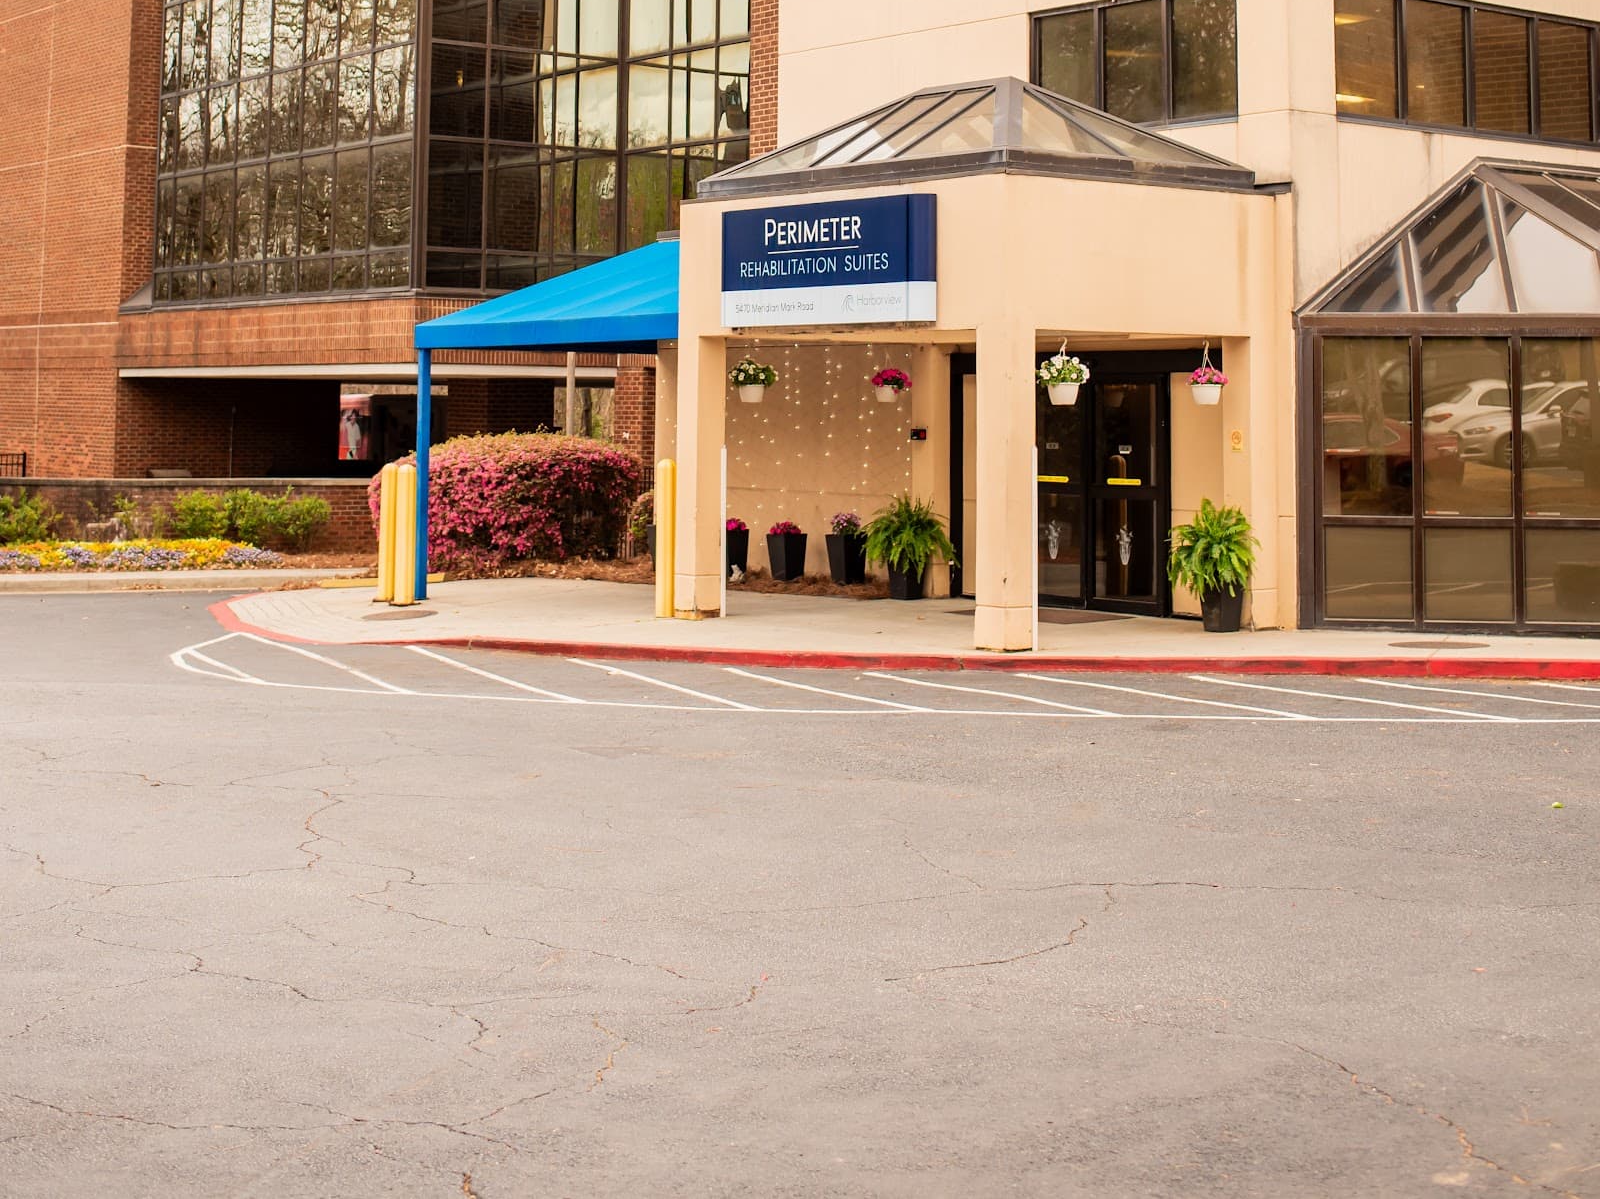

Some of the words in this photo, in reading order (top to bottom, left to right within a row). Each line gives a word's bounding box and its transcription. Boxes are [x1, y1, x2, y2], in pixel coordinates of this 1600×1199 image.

[764, 215, 862, 246] PERIMETER
[740, 256, 837, 278] REHABILITATION
[844, 252, 889, 272] SUITES
[735, 303, 751, 314] 5470
[751, 302, 779, 314] Meridian
[780, 301, 795, 312] Mark
[797, 301, 814, 312] Road
